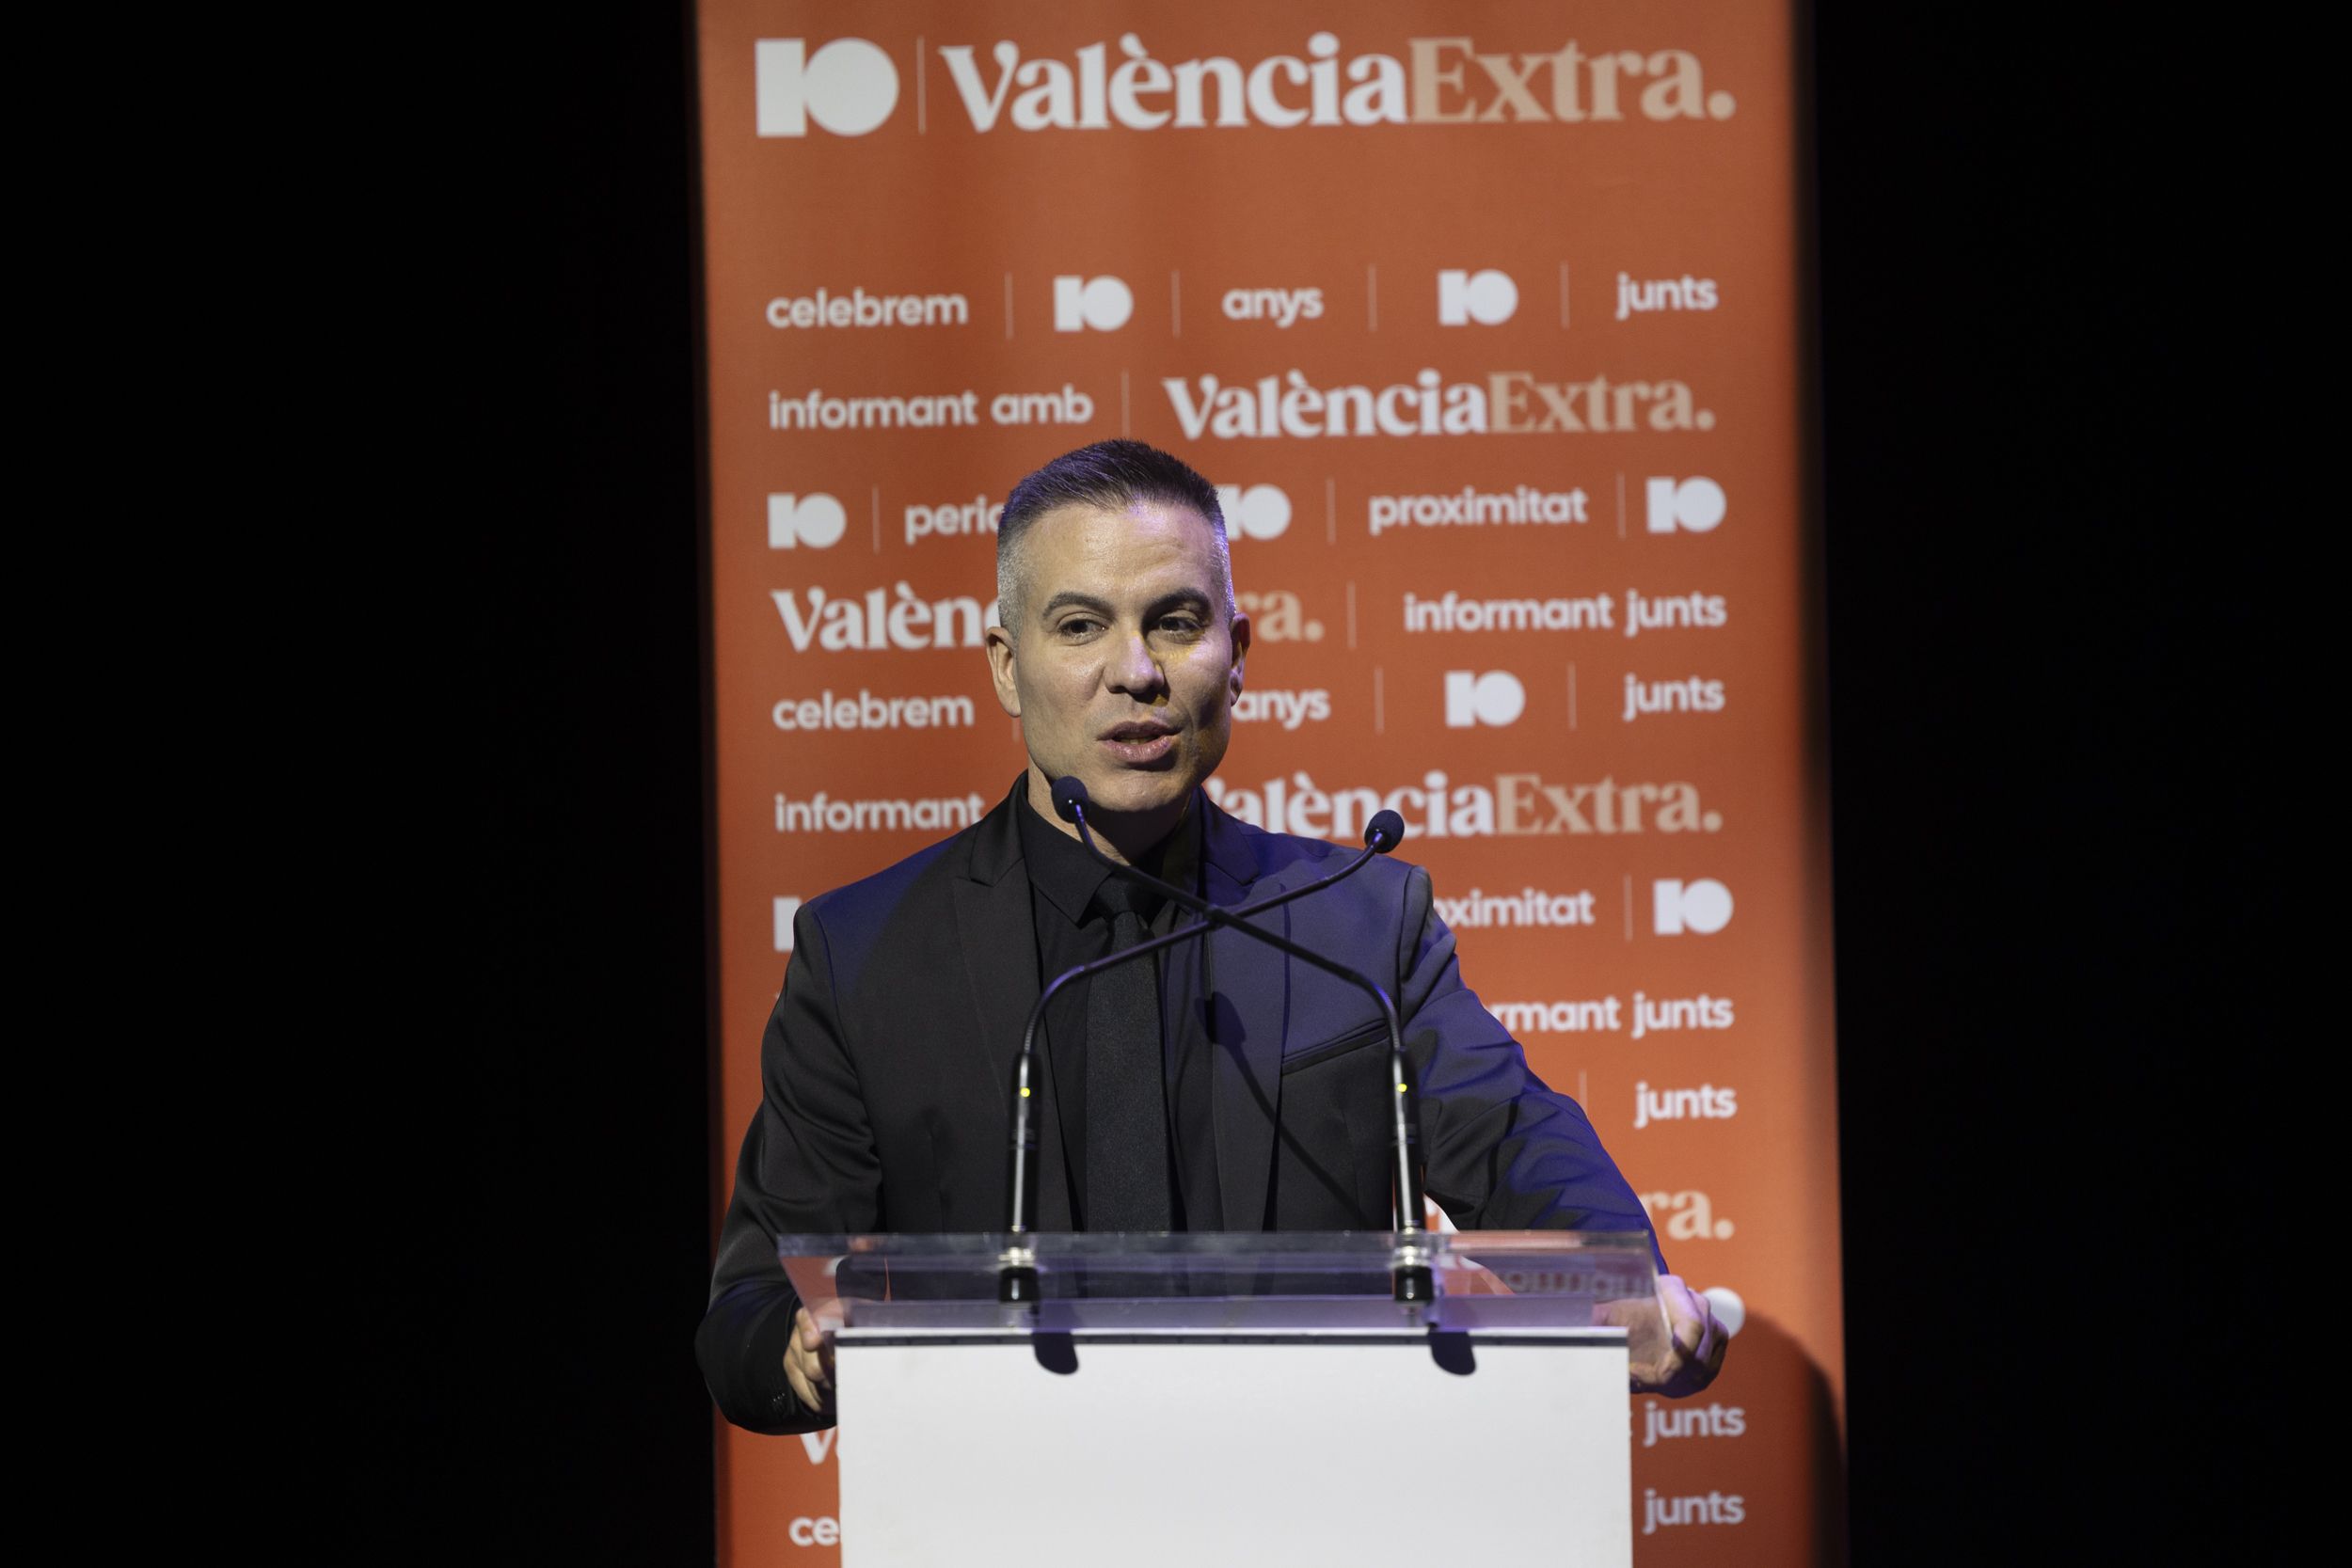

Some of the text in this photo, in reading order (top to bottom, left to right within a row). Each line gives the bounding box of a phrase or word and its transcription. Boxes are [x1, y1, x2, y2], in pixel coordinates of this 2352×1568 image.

[765, 287, 968, 329] celebrem
[1222, 288, 1325, 328] anys
[1615, 273, 1719, 321] junts
[769, 389, 978, 430] informant
[991, 384, 1094, 425] amb
[1369, 485, 1587, 536] proximitat
[1404, 592, 1613, 632] informant
[1625, 589, 1727, 638] junts
[771, 689, 975, 731] celebrem
[1231, 689, 1331, 730] anys
[1623, 673, 1725, 722] junts
[774, 769, 1722, 839] informant alènciaExtra.
[1631, 991, 1735, 1039] junts
[1634, 1082, 1738, 1130] junts
[1643, 1401, 1746, 1448] junts
[1643, 1488, 1745, 1535] junts
